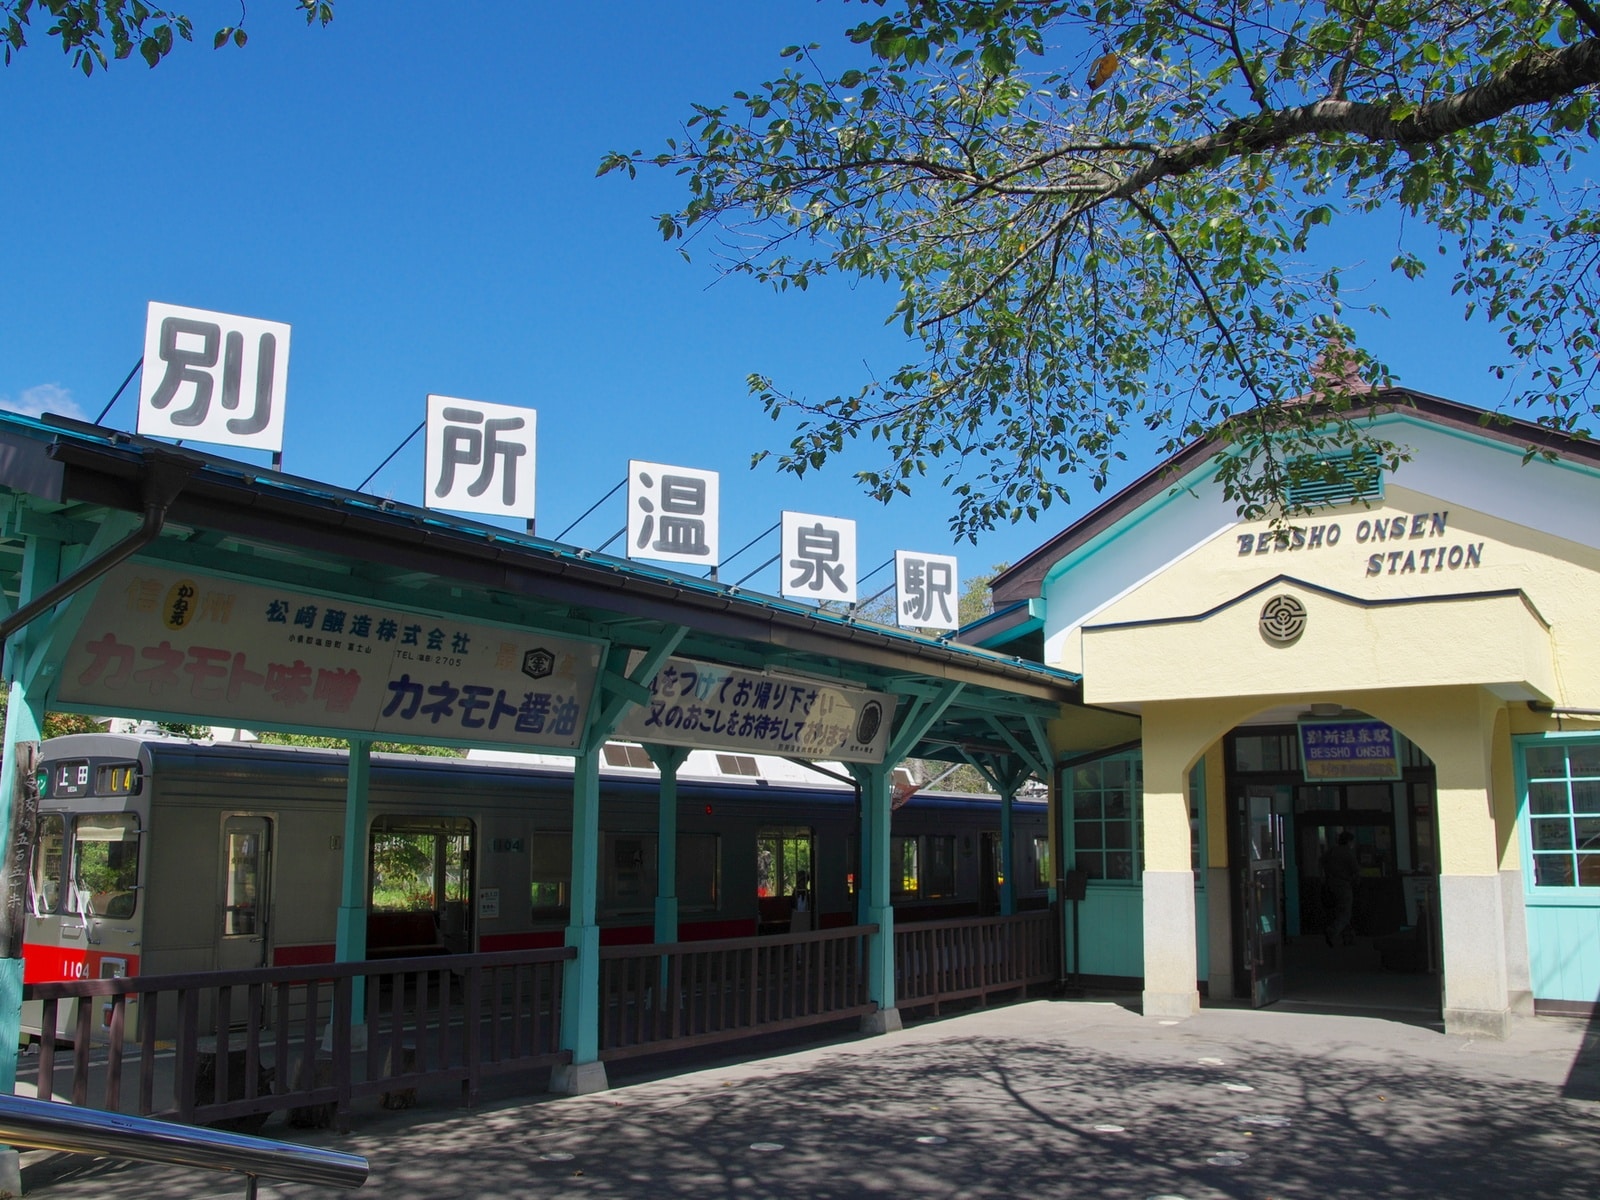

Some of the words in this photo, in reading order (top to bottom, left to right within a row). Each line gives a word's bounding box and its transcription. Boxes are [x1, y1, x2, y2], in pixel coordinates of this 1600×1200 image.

[150, 316, 277, 435] 別
[434, 406, 527, 507] 所
[636, 471, 711, 557] 温
[789, 522, 849, 594] 泉
[902, 557, 953, 624] 駅
[1237, 523, 1342, 557] BESSHO
[1355, 511, 1449, 544] ONSEN
[1366, 543, 1485, 577] STATION
[77, 631, 362, 715] カネモト味噌
[396, 649, 414, 661] TEL
[435, 656, 462, 668] 2705
[382, 673, 580, 736] カネモト醤油
[644, 699, 852, 749] 又のおこしをお待ちしております
[1305, 728, 1391, 745] 別所温泉駅
[1310, 746, 1351, 759] BESSHO
[1355, 745, 1391, 758] ONSEN
[59, 765, 89, 787] 上田
[63, 959, 90, 979] 1104
